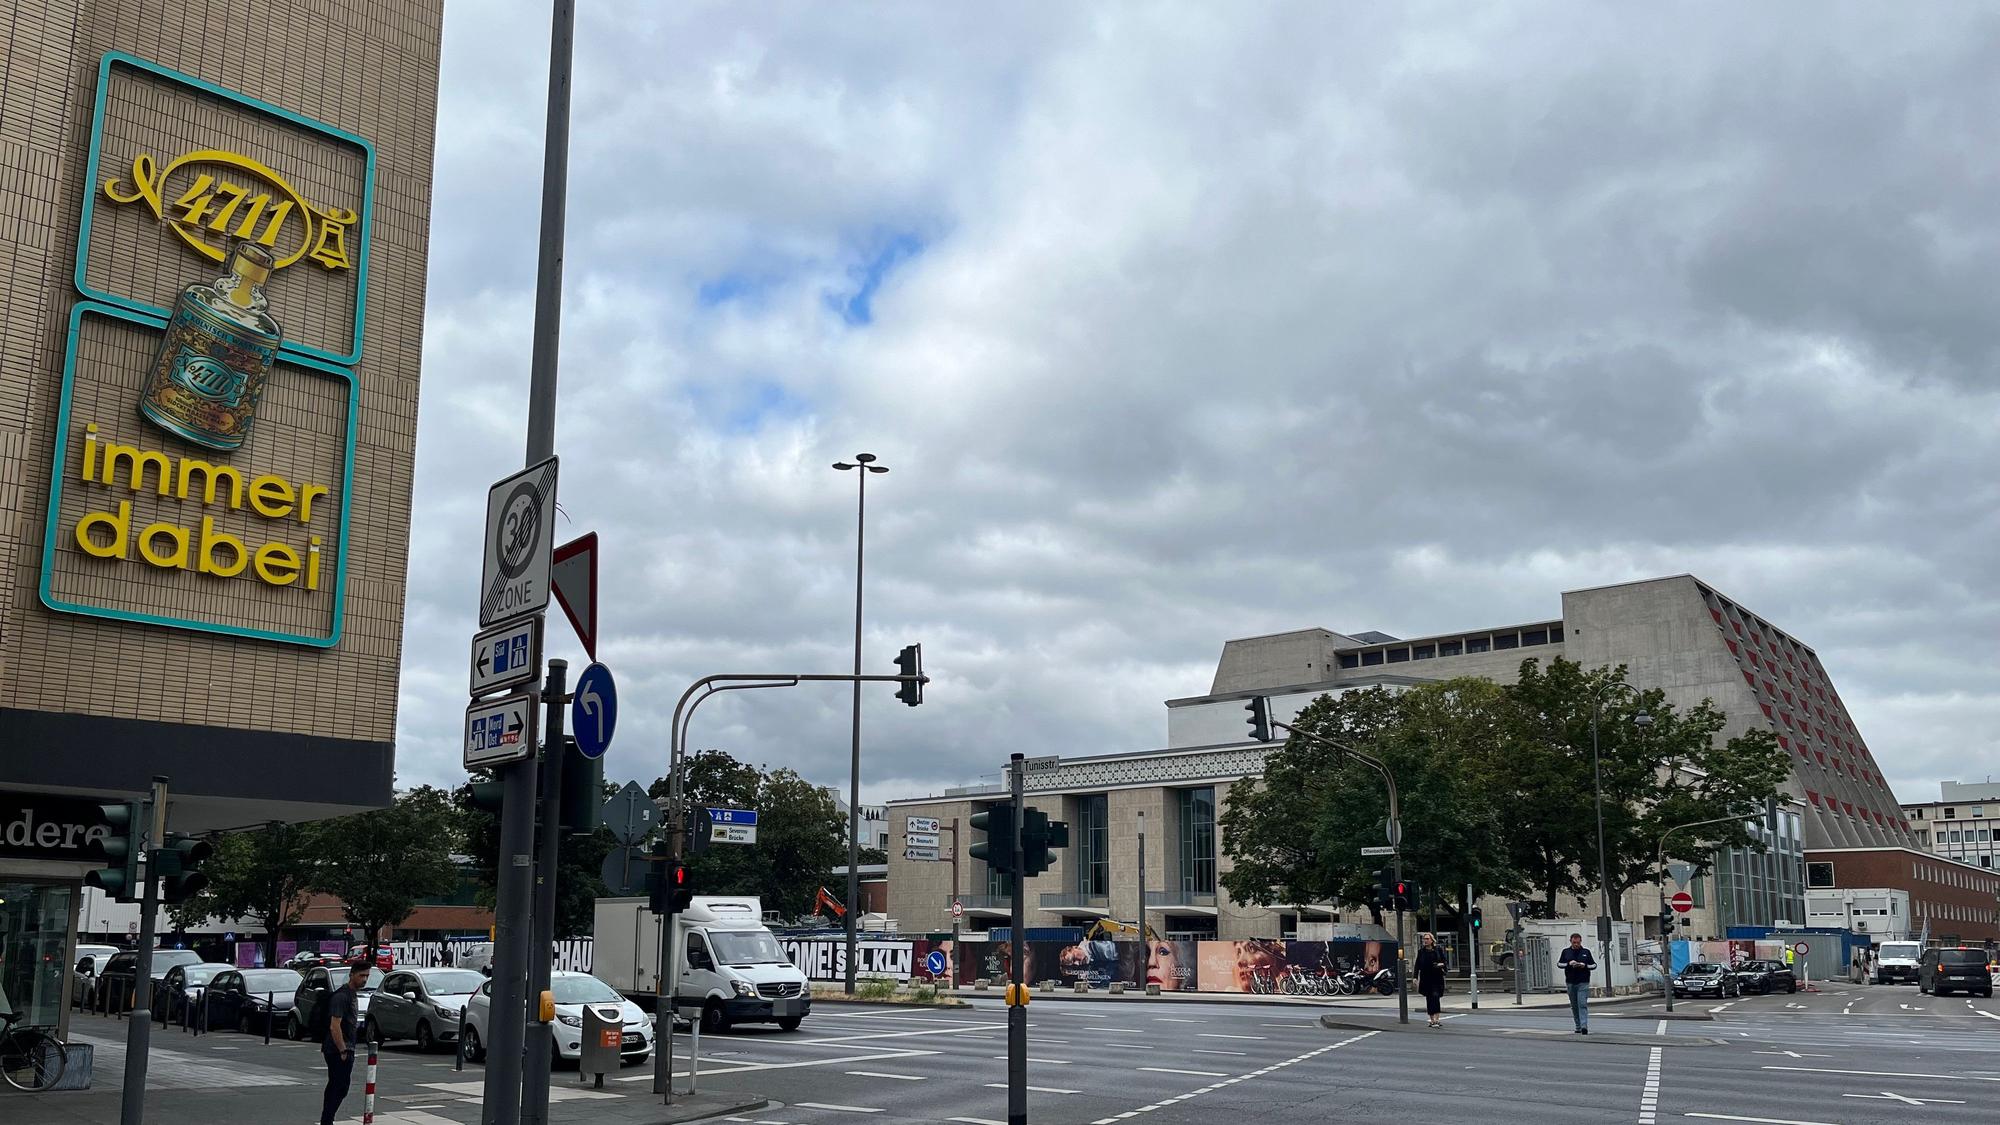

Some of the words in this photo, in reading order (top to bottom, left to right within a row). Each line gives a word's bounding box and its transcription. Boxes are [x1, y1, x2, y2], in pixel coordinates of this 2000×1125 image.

[174, 174, 294, 247] 4711
[81, 423, 329, 523] immer
[76, 500, 321, 591] dabei
[505, 505, 534, 553] 30
[497, 579, 532, 612] ZONE
[495, 642, 505, 658] Süd
[489, 716, 502, 732] Nord
[489, 732, 498, 747] Ost
[1024, 760, 1057, 772] Tunisstr.
[0, 808, 112, 849] dere
[784, 941, 833, 979] OME!
[835, 948, 869, 972] SL
[872, 948, 912, 973] KLN
